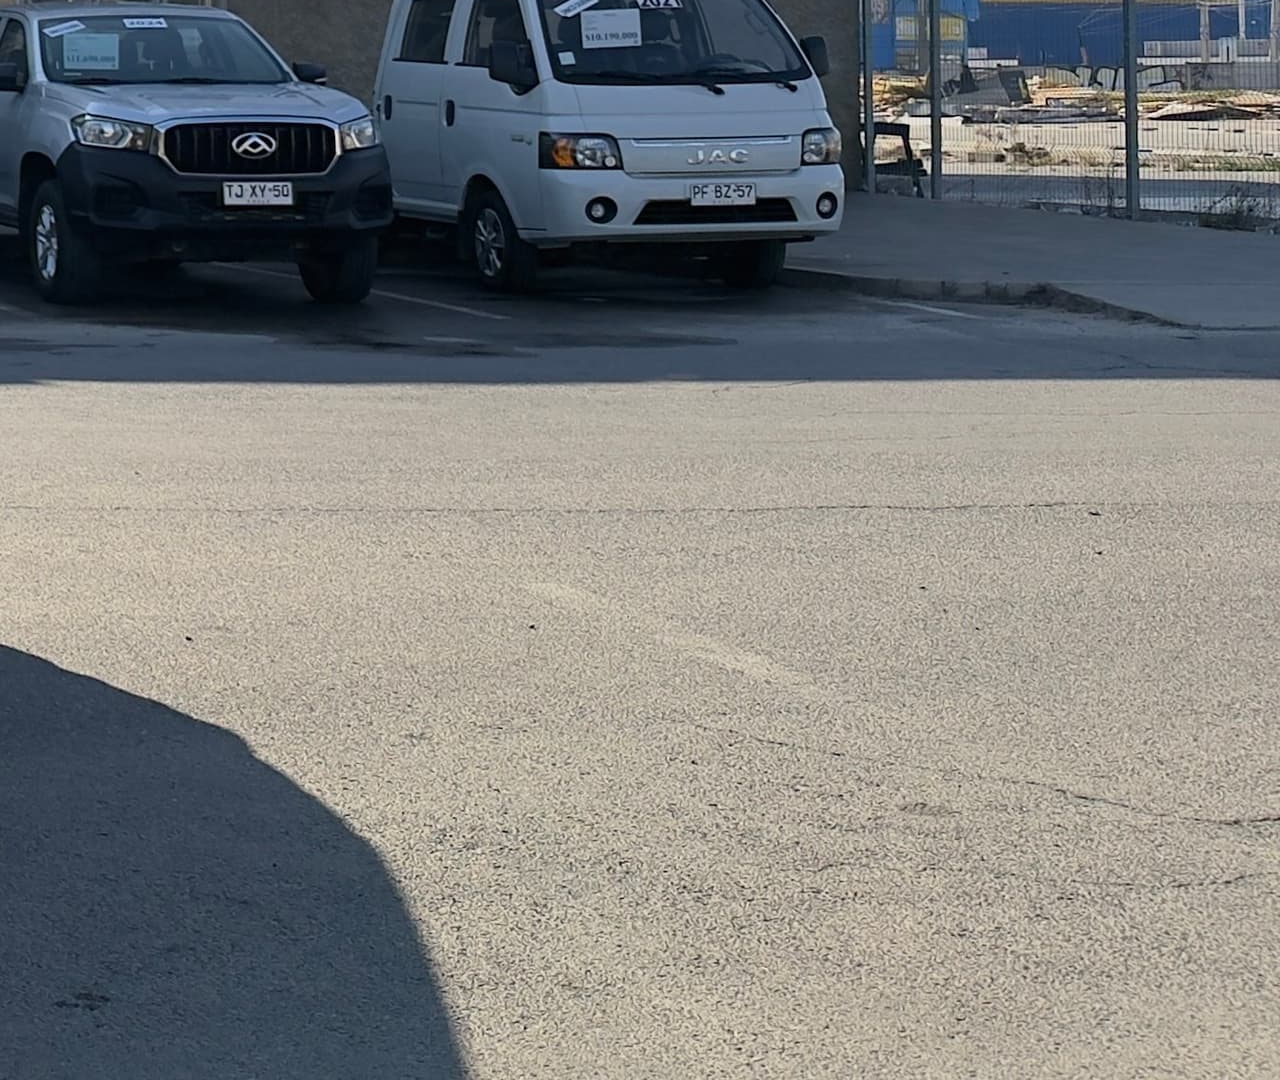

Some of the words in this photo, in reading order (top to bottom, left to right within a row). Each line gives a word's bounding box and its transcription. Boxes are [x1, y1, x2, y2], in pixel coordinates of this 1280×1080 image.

[687, 149, 749, 165] JAC
[225, 184, 244, 199] TJ
[693, 185, 709, 199] PF
